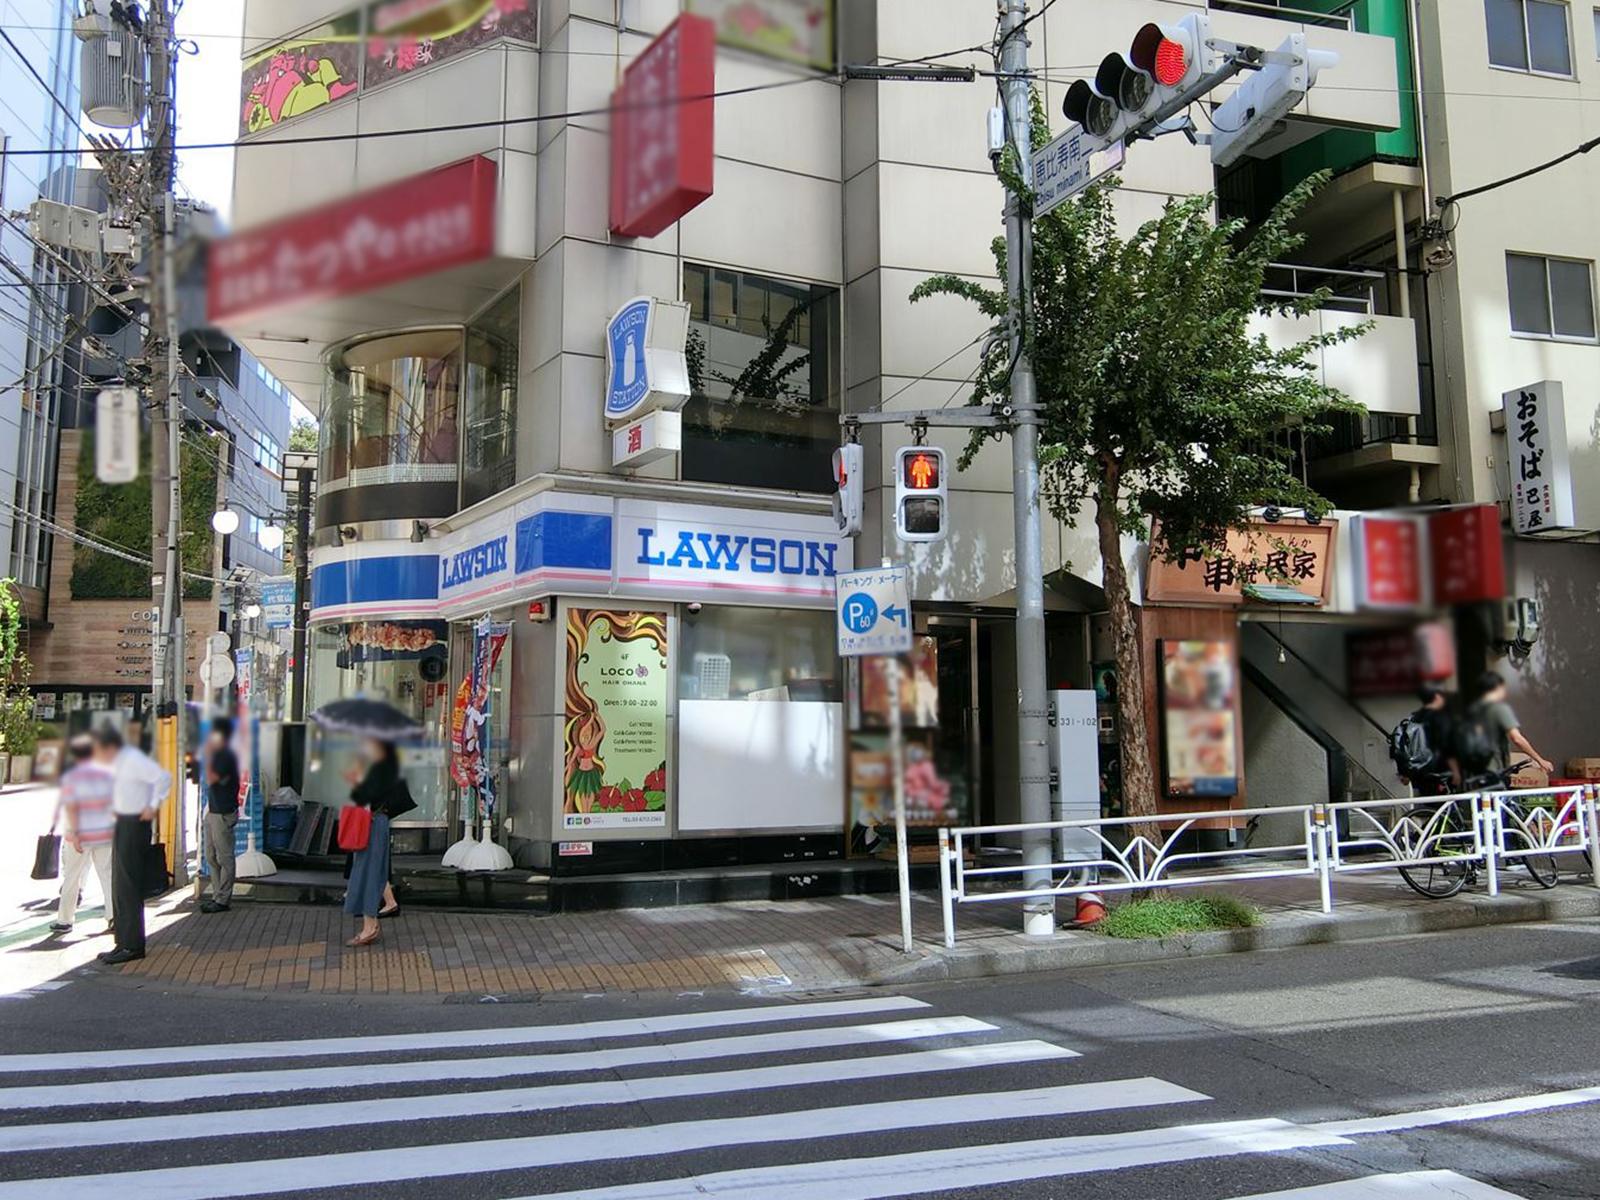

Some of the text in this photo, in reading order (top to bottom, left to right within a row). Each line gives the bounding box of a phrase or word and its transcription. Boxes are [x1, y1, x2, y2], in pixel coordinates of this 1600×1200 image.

[1056, 167, 1083, 196] minami
[613, 309, 647, 339] LAWSON
[612, 375, 647, 404] STATION
[628, 424, 642, 454] 酒
[442, 535, 508, 590] LAWSON
[637, 528, 838, 577] LAWSON
[285, 605, 291, 616] 3
[849, 602, 864, 629] P
[600, 667, 634, 676] LOCO
